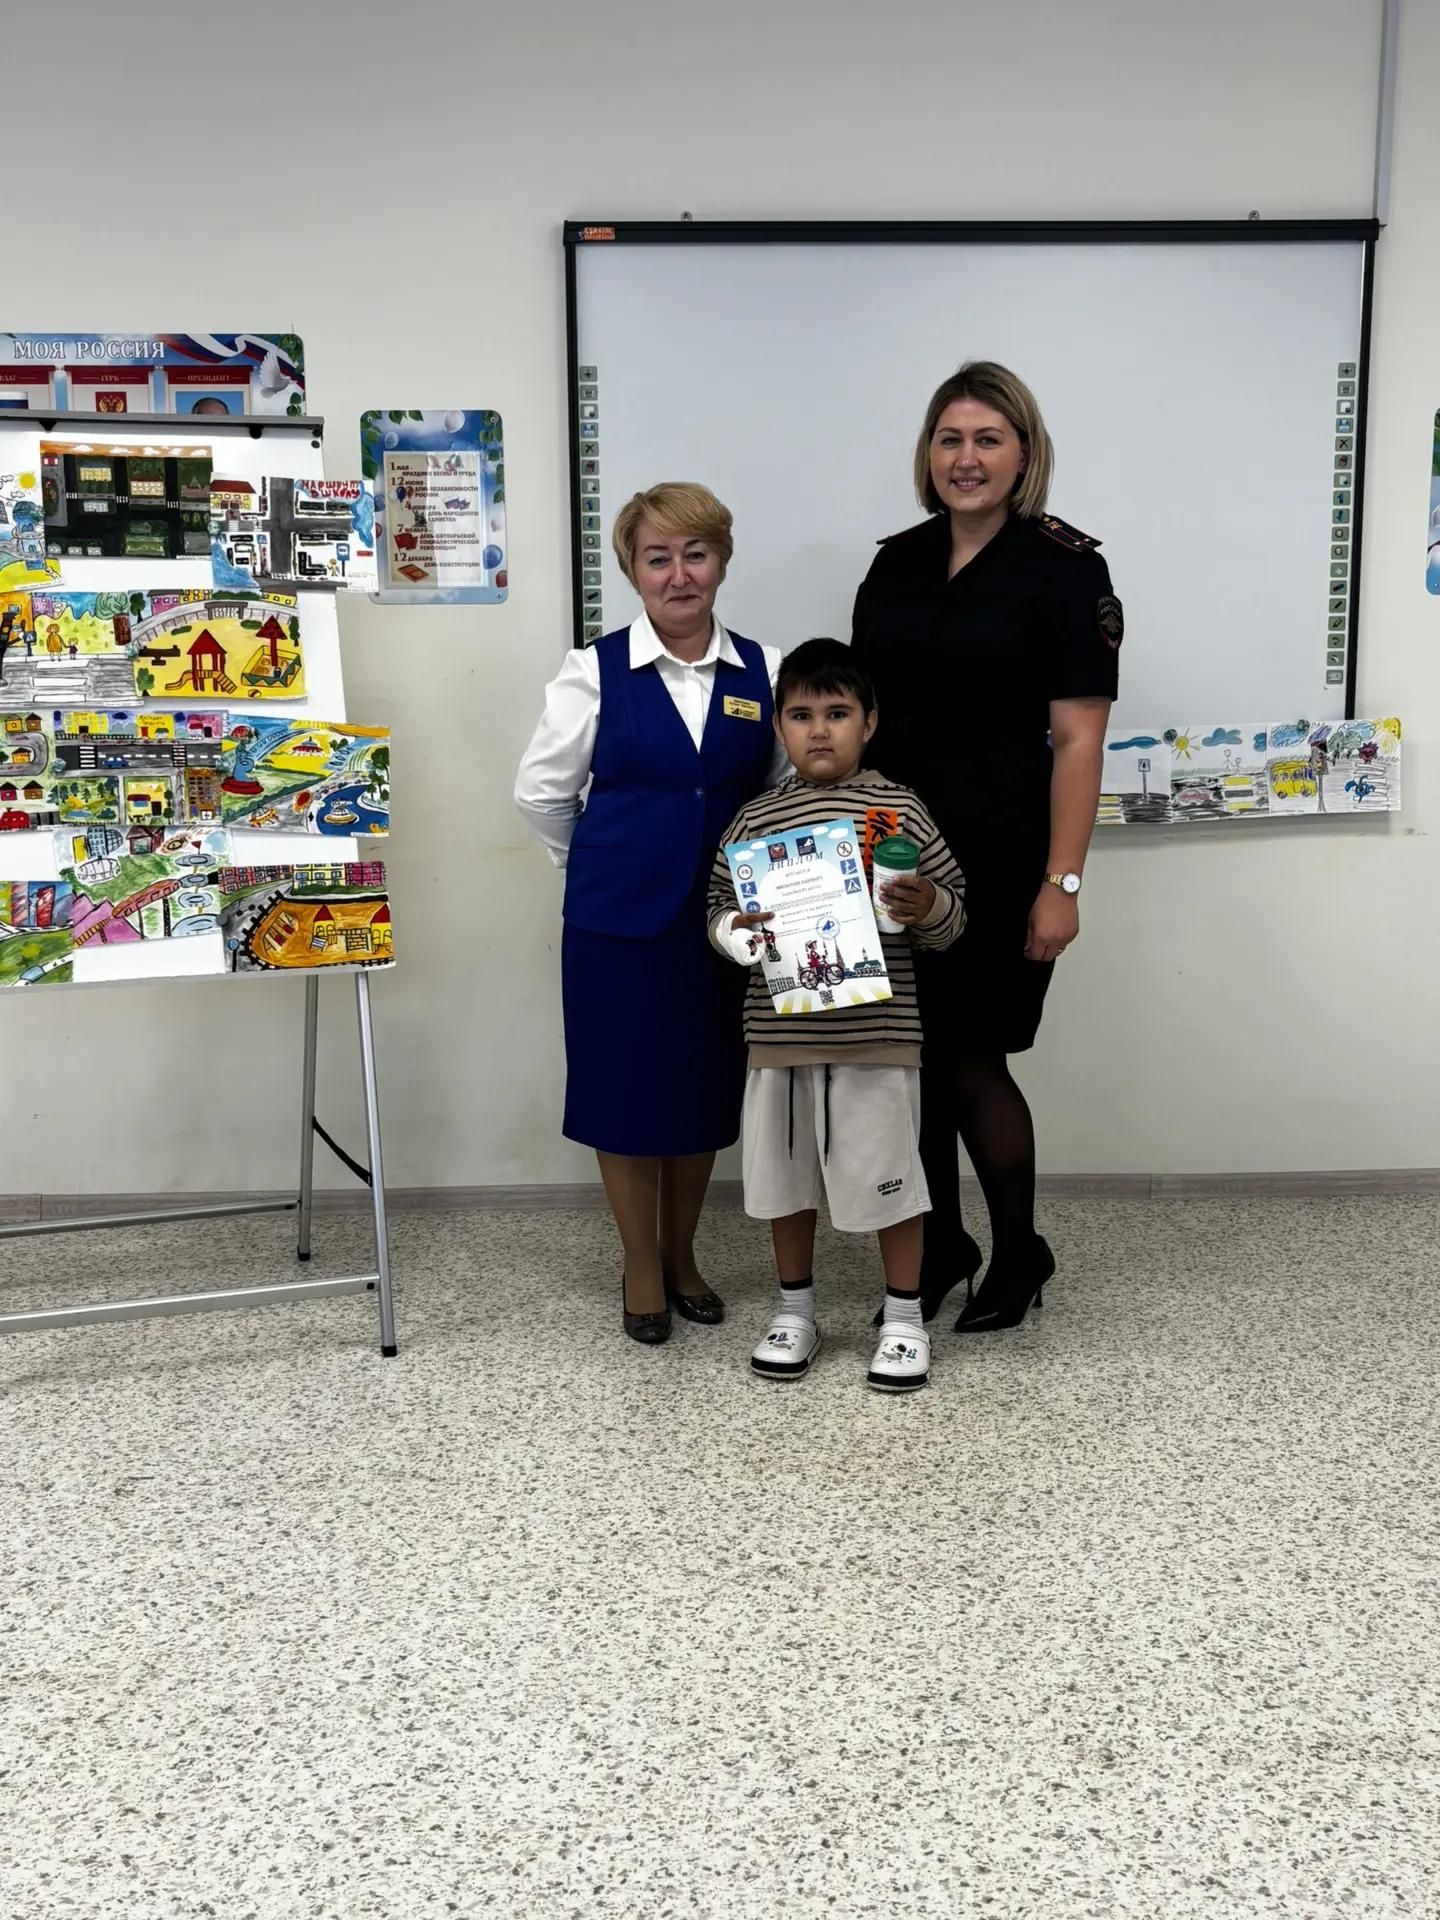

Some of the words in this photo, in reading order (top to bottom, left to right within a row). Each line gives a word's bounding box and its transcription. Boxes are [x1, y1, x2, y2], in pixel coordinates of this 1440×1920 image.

[13, 340, 66, 359] МОЯ
[75, 340, 166, 359] РОССИЯ
[390, 462, 395, 471] 1
[391, 477, 404, 486] 12
[397, 524, 404, 532] 7
[394, 553, 407, 561] 12
[767, 851, 823, 872] ДИПЛОМ
